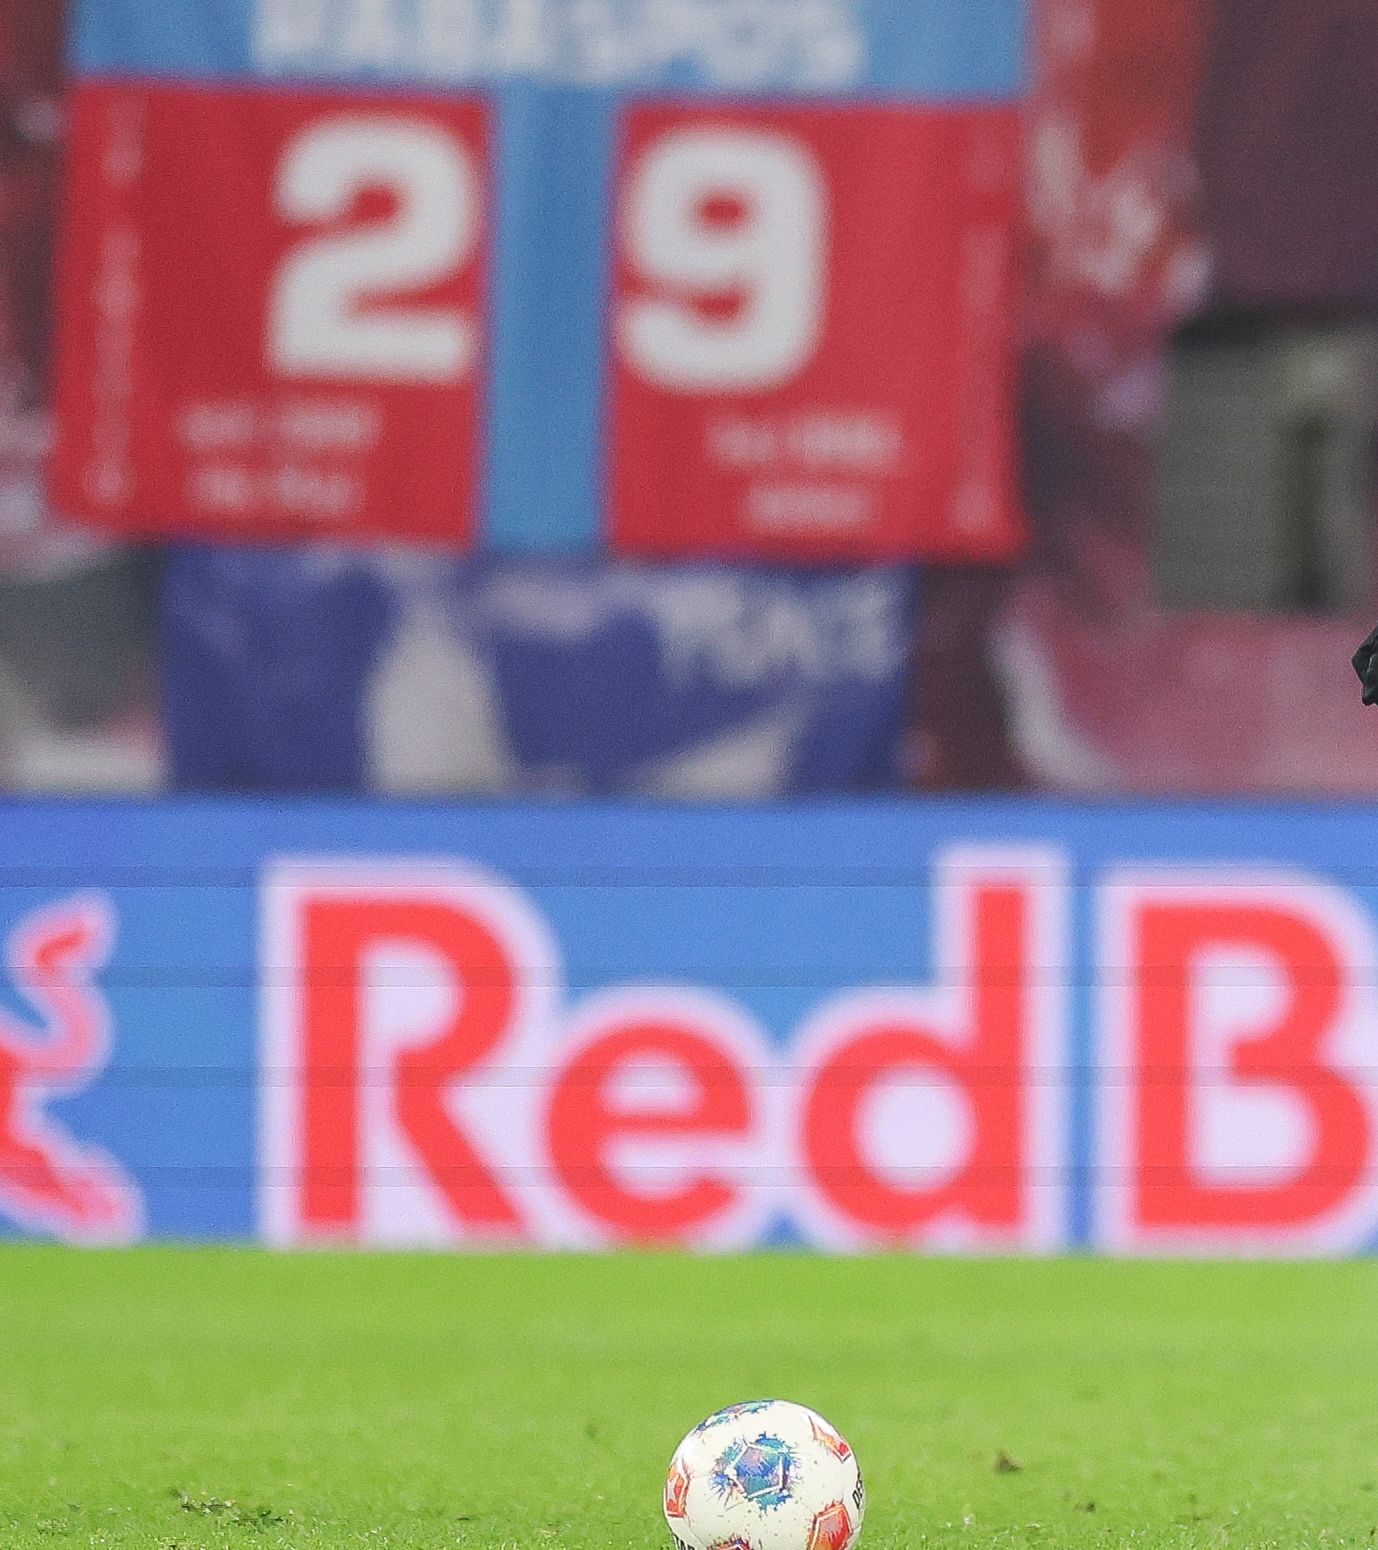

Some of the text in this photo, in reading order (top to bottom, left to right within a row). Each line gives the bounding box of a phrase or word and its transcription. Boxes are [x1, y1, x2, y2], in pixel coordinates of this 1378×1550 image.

[268, 116, 478, 380] 2
[620, 127, 828, 396] 9
[298, 882, 1030, 1242] Red
